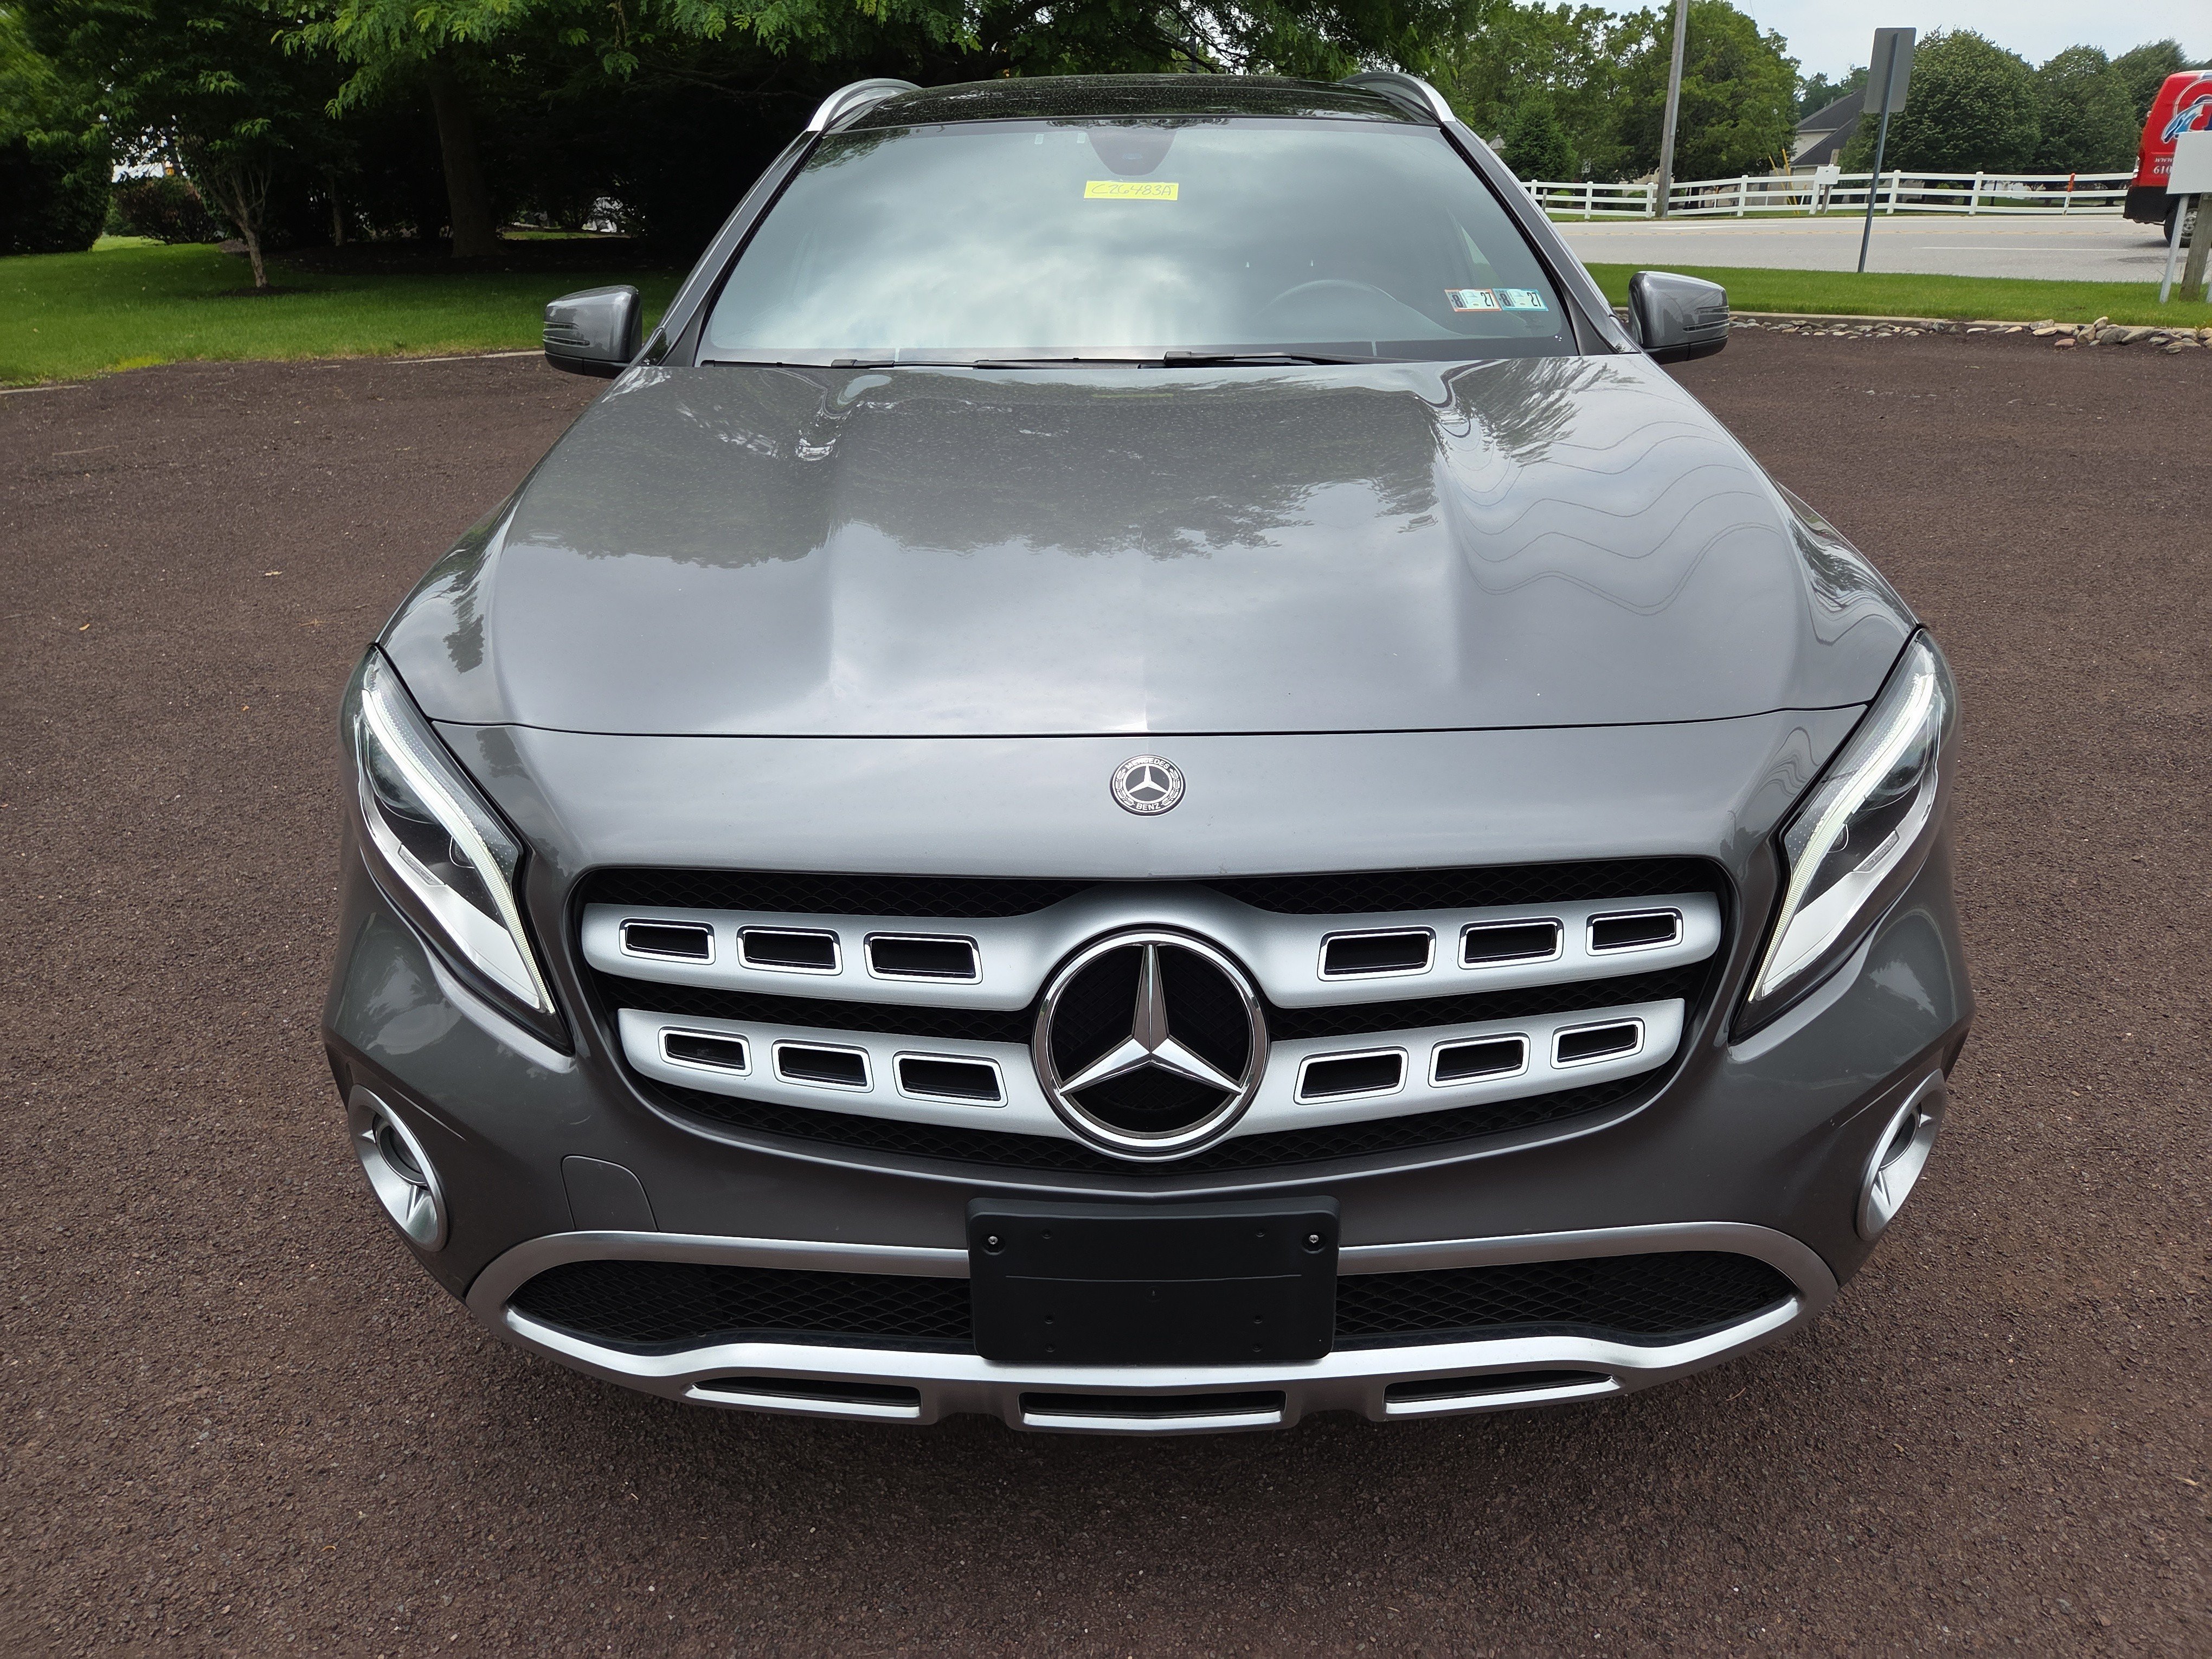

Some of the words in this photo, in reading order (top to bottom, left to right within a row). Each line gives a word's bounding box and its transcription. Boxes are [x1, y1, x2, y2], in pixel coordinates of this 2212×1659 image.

[1091, 184, 1173, 196] C26483A
[1451, 294, 1464, 308] 8
[1480, 292, 1495, 308] 27
[1499, 293, 1512, 307] 8
[1526, 292, 1541, 307] 27
[1125, 757, 1171, 769] MERCEDES
[1136, 802, 1161, 811] BENZ
